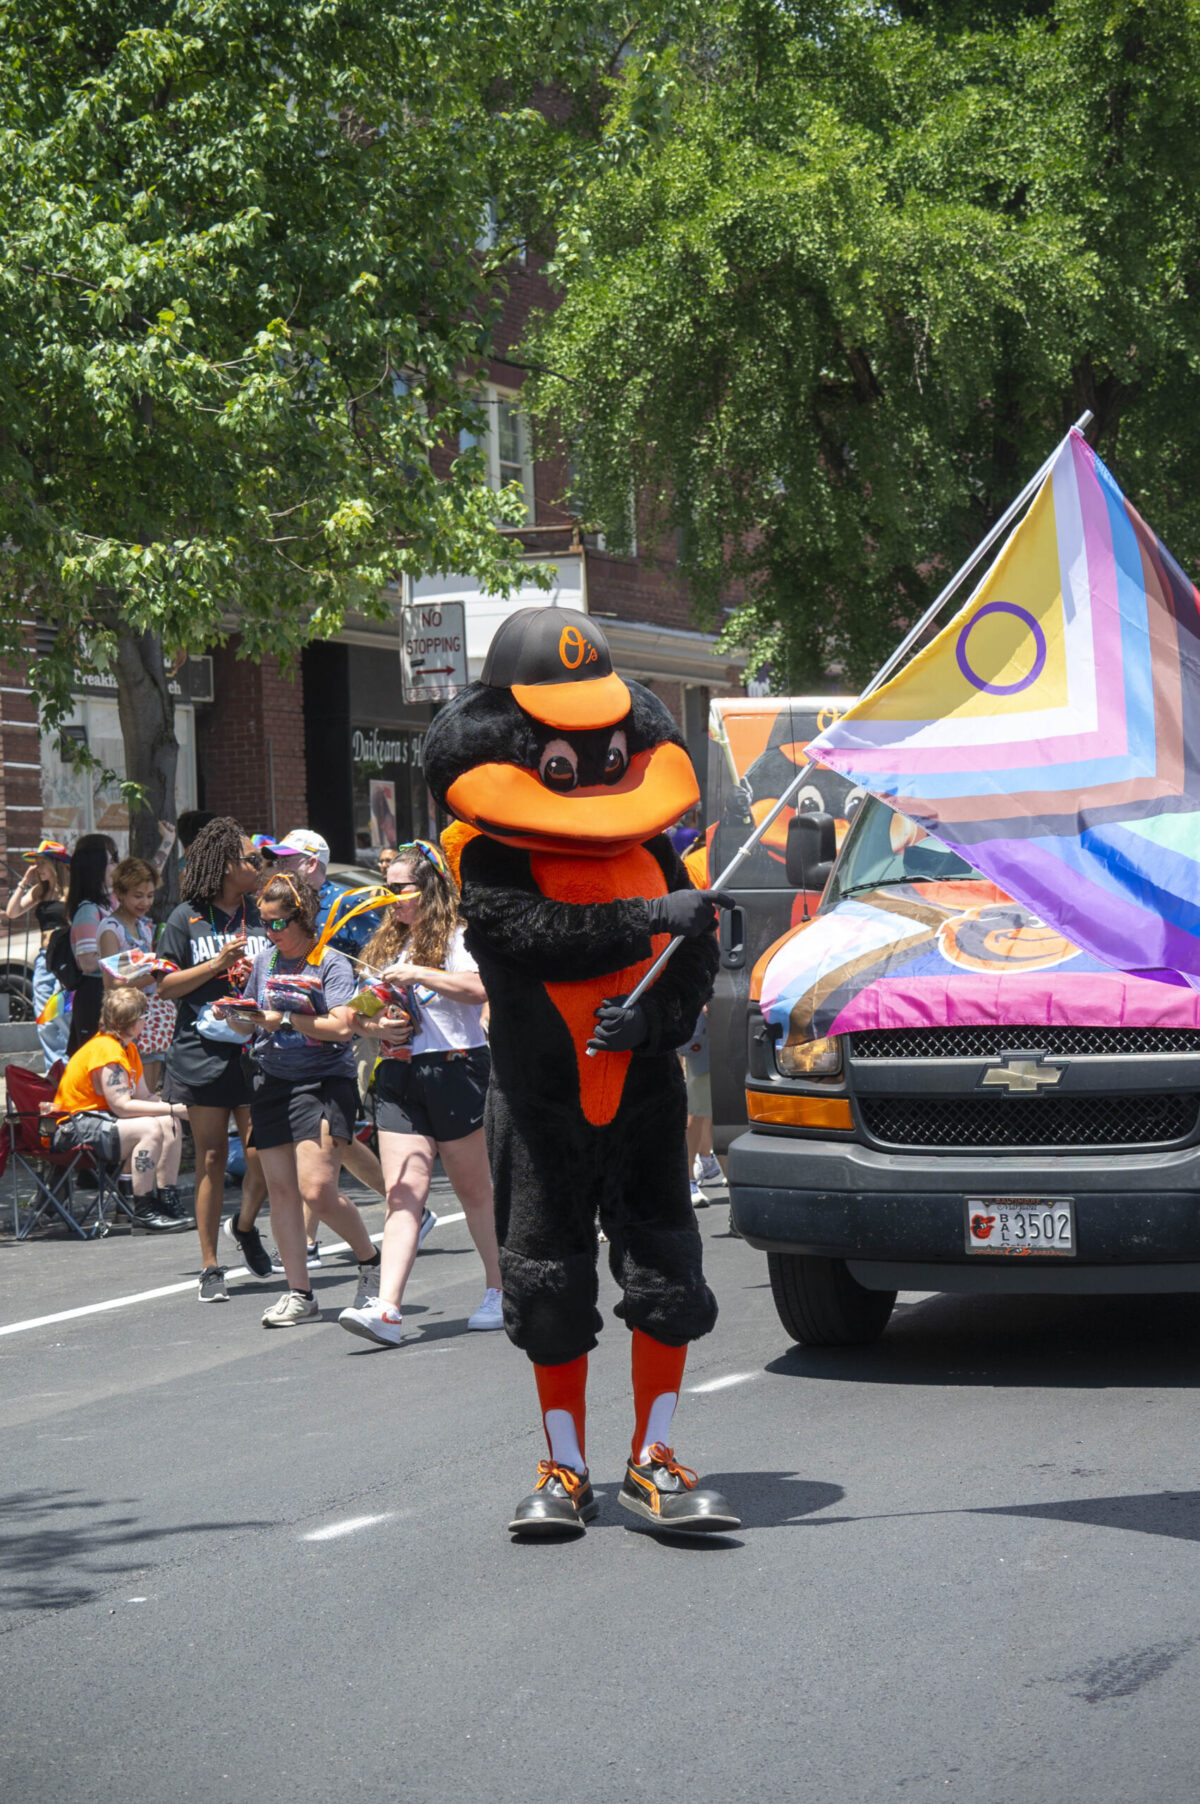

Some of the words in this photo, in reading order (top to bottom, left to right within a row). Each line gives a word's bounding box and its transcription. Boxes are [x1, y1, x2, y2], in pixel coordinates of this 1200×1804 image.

[421, 609, 443, 628] NO
[406, 636, 462, 656] STOPPING
[558, 625, 598, 669] O's
[74, 668, 119, 688] Breakfa
[190, 933, 273, 966] BALTOR
[1014, 1212, 1070, 1240] 3502
